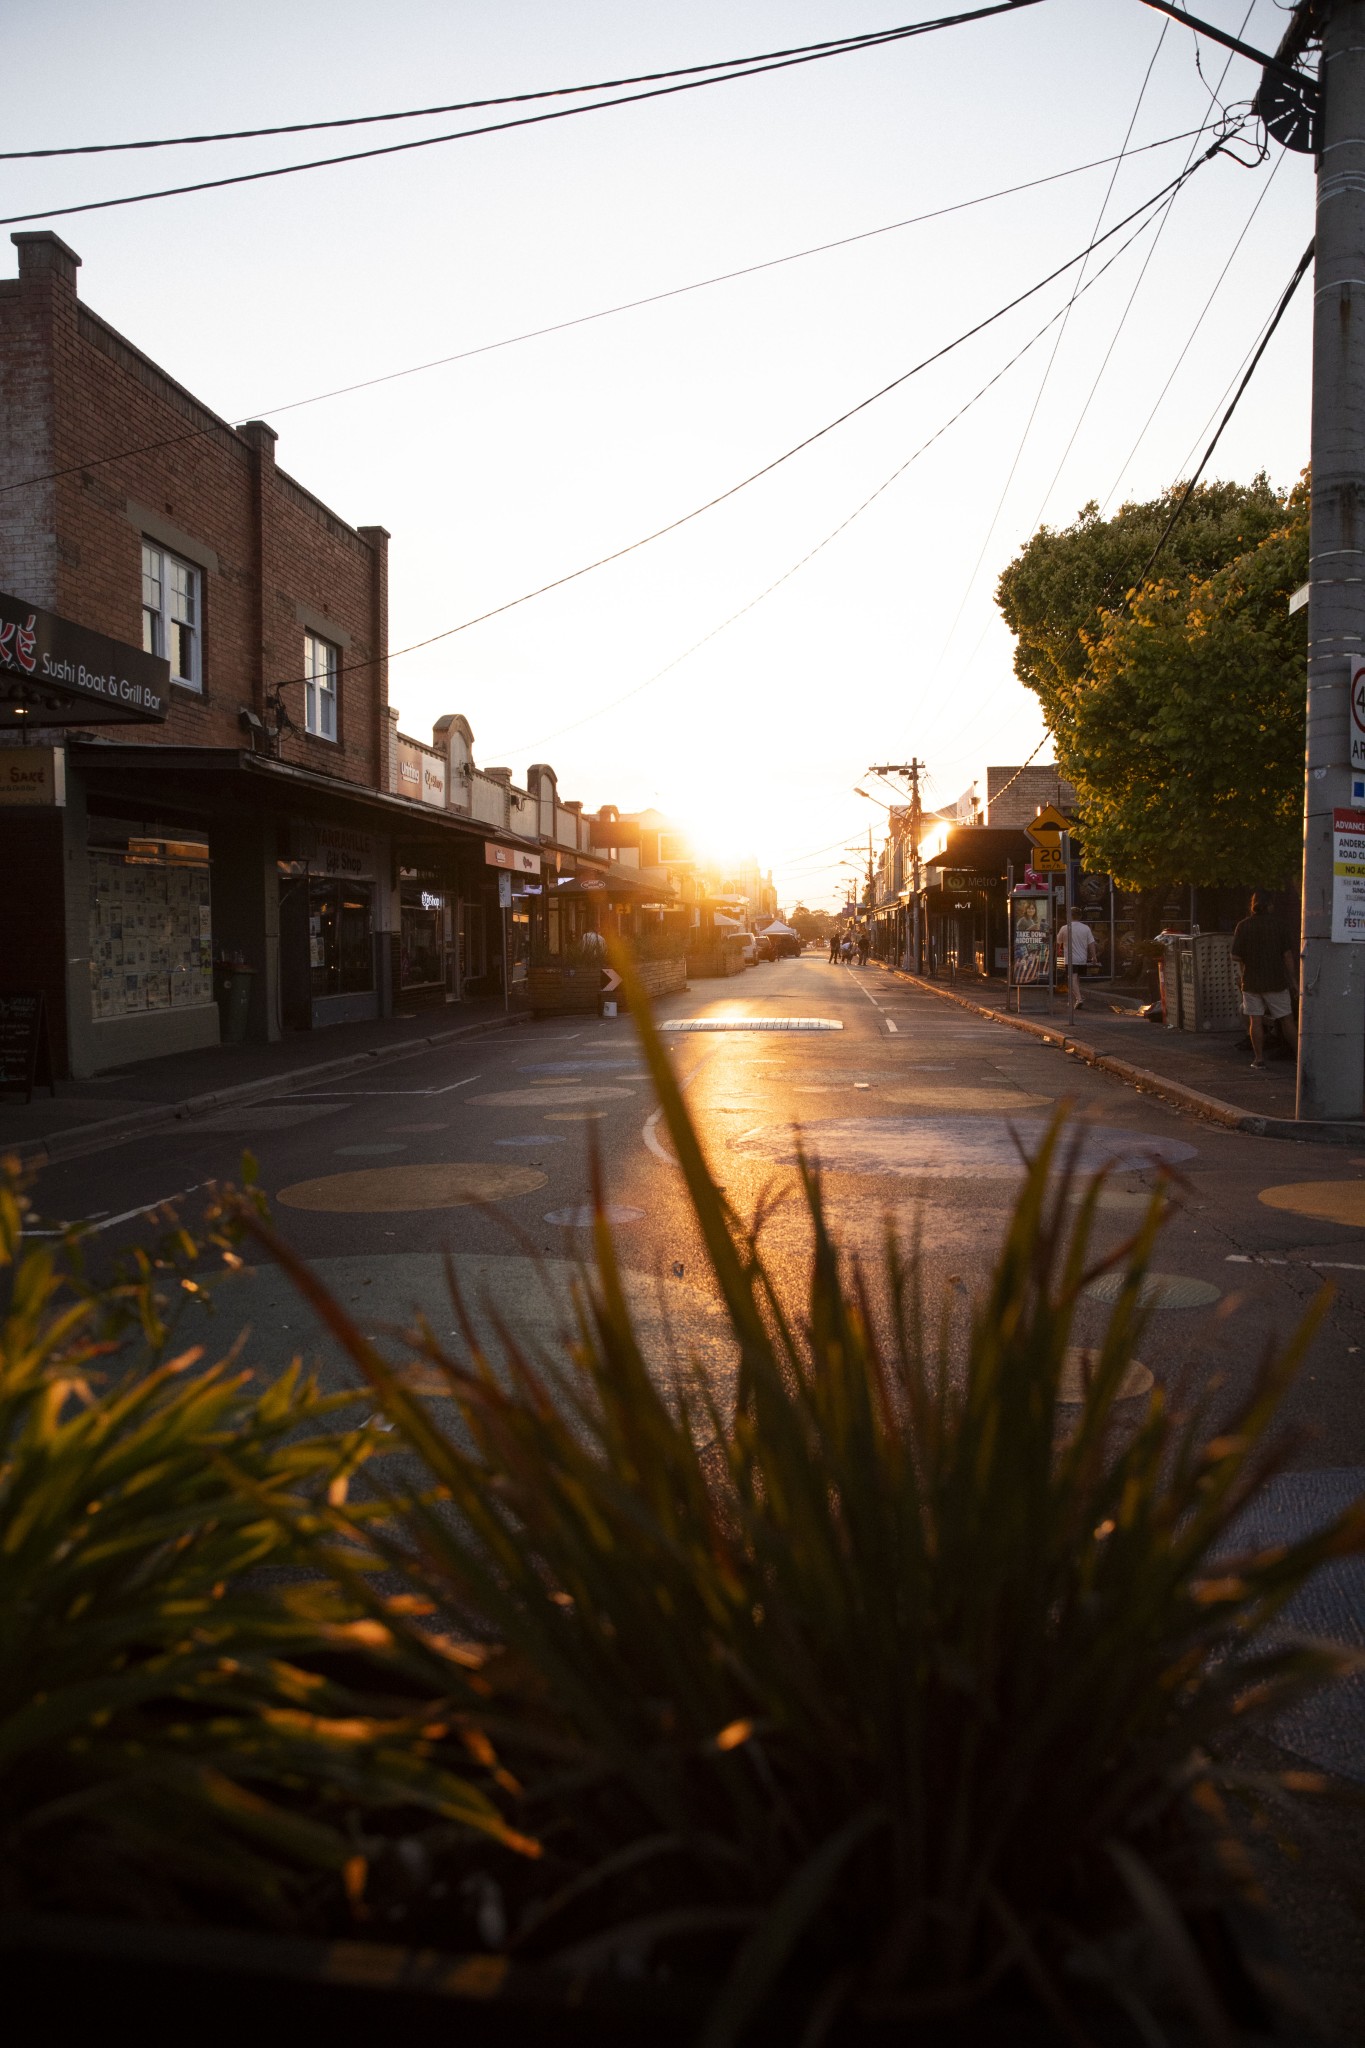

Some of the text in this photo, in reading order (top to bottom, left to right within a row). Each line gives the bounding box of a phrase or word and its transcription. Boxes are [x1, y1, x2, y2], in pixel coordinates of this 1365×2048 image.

[42, 653, 161, 710] Sushi Boat & Grill Bar
[1040, 849, 1061, 862] 20
[1339, 850, 1357, 859] ROAD
[341, 851, 362, 875] Shop
[1345, 865, 1355, 874] NO
[968, 876, 997, 887] Metro
